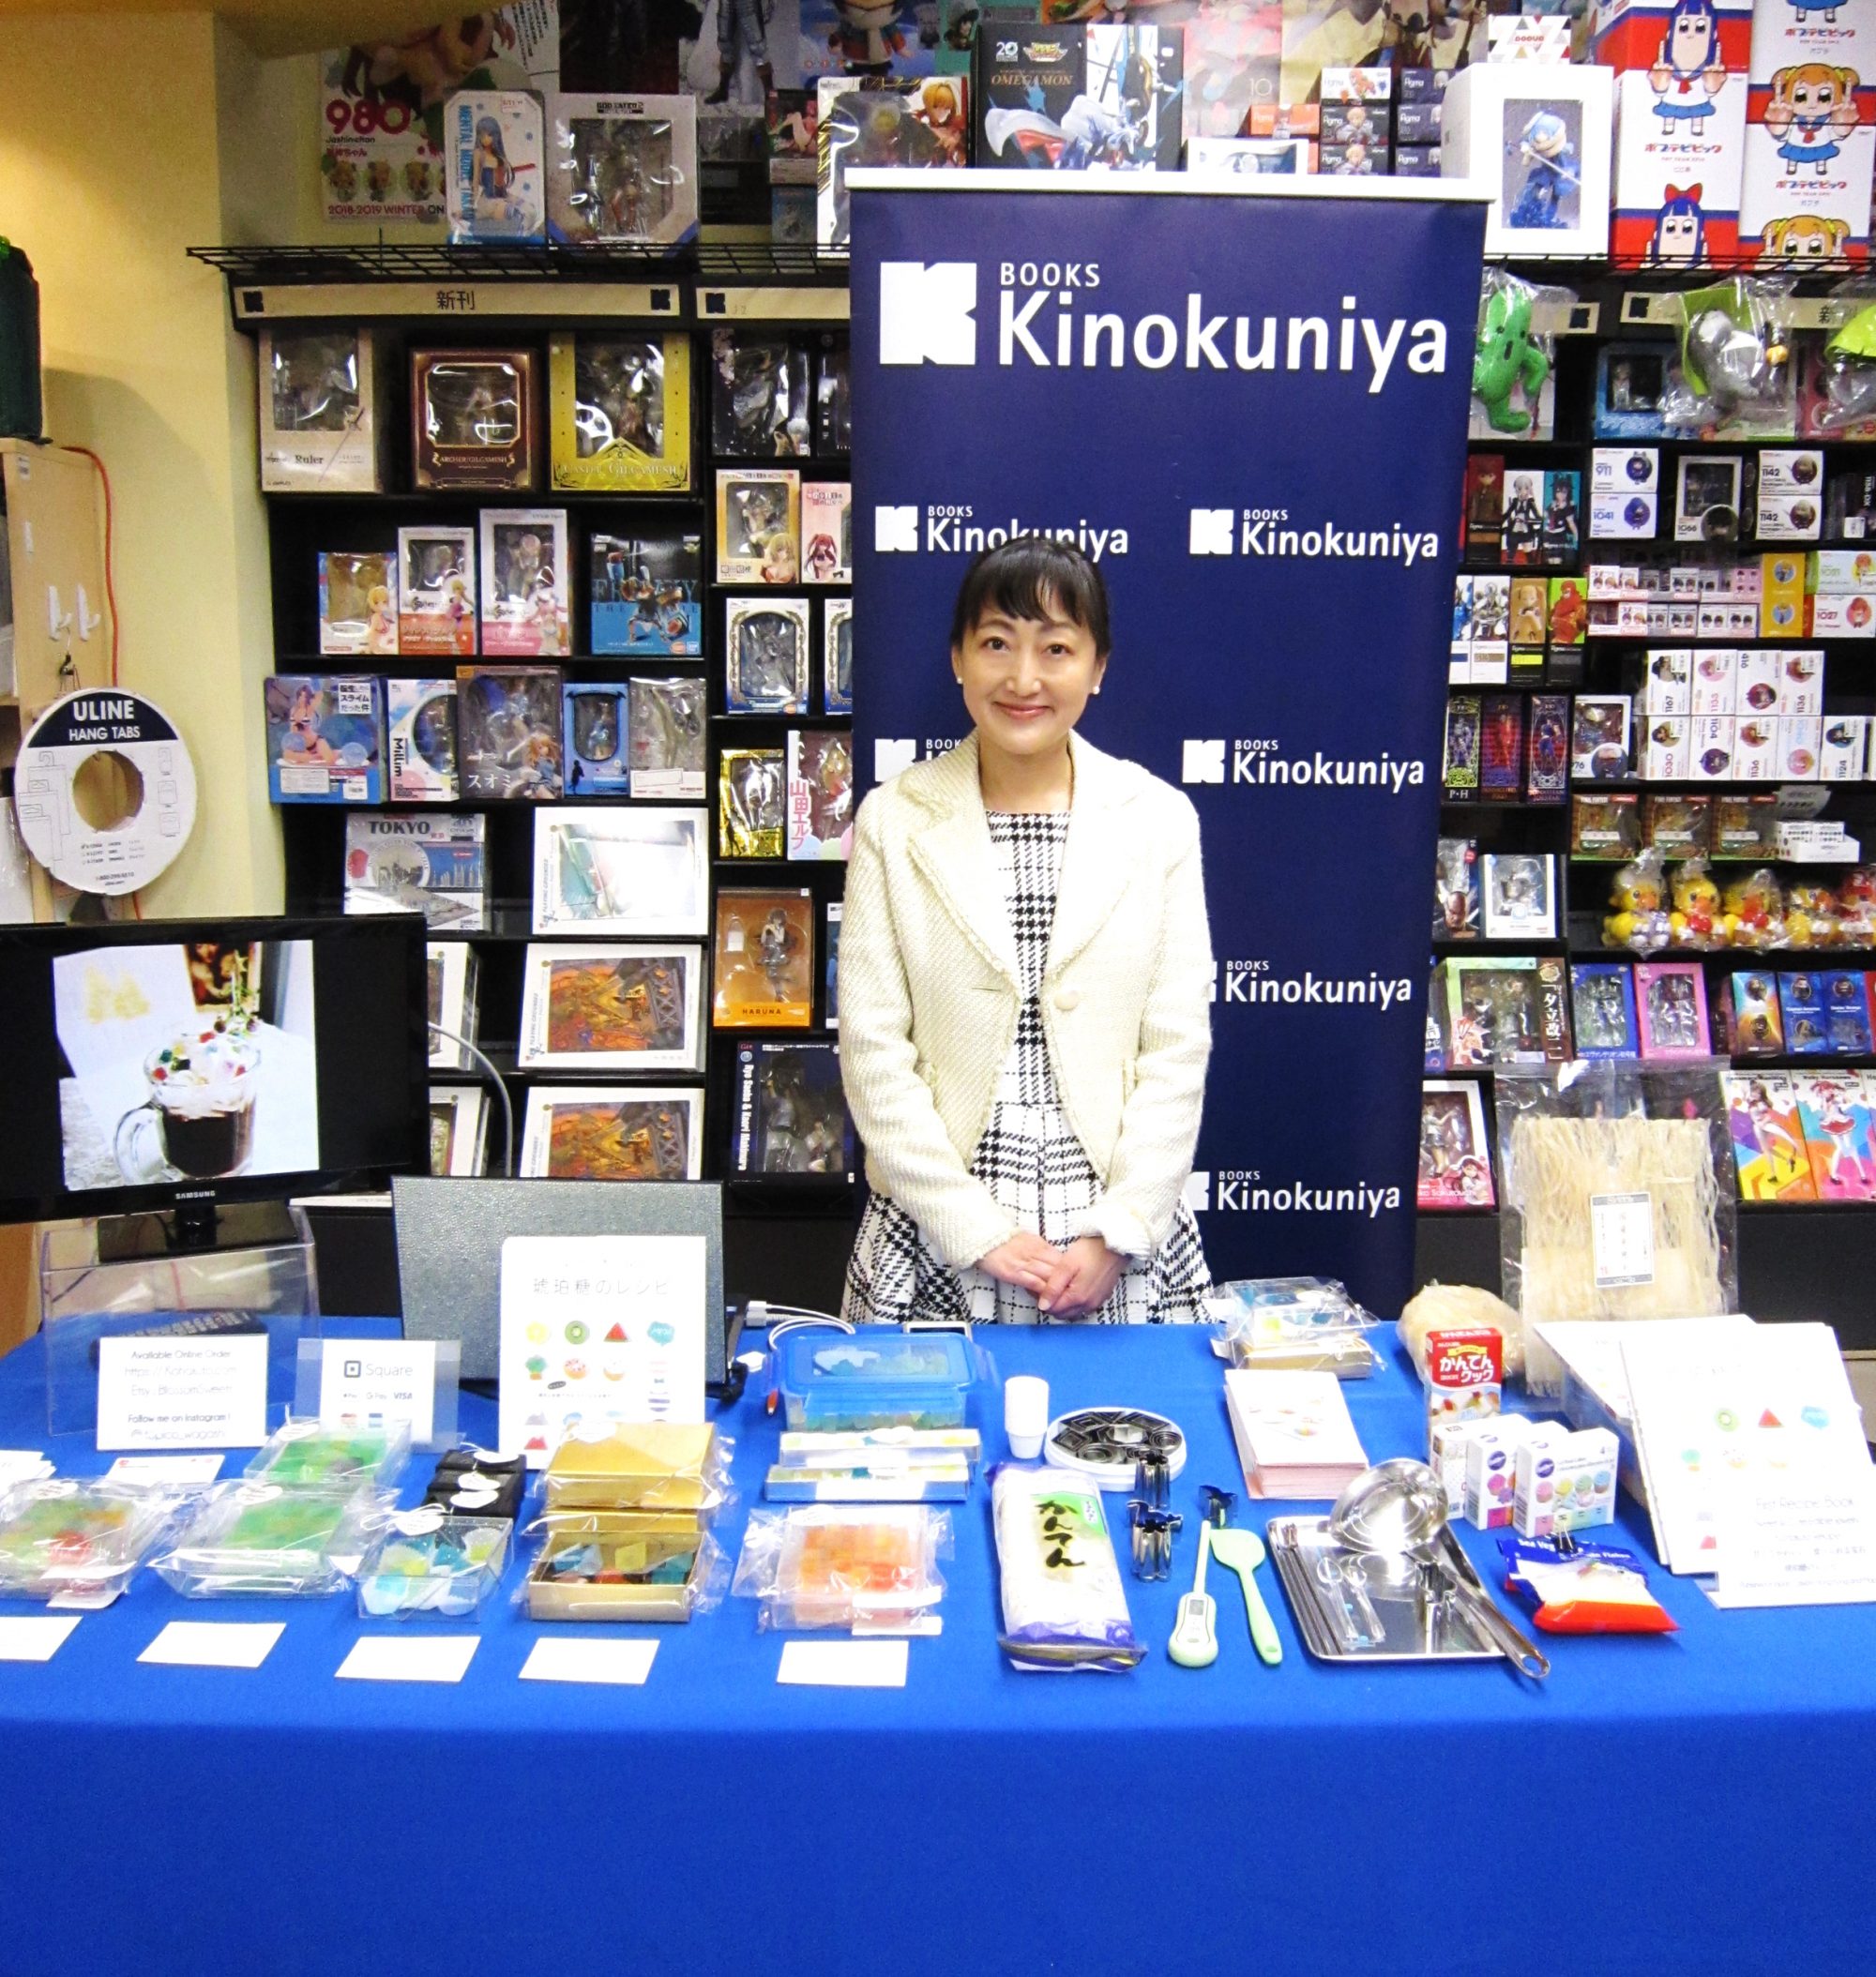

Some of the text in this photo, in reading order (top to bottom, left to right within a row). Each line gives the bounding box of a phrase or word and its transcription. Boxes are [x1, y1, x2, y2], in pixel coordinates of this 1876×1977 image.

[991, 74, 1073, 85] OMEGAMON
[1249, 77, 1273, 97] 10
[325, 98, 411, 135] 980
[1644, 143, 1722, 155] ポプテピピック
[328, 204, 384, 216] 2018-2019
[386, 204, 425, 215] WINTER
[1000, 263, 1101, 288] BOOKS
[436, 290, 477, 311] 新刊
[999, 290, 1447, 394] Kinokuniya
[295, 454, 325, 465] Ruler
[1596, 465, 1612, 476] 911
[1762, 468, 1780, 476] 1142
[928, 506, 973, 517] BOOKS
[1243, 509, 1289, 521] BOOKS
[1594, 511, 1613, 521] 1041
[1760, 513, 1779, 521] 1142
[1678, 524, 1697, 533] 1066
[1242, 521, 1439, 566] Kinokuniya
[1817, 611, 1838, 620] 1027
[340, 694, 370, 702] スライム
[1665, 695, 1673, 713] 1167
[1796, 695, 1806, 713] 1136
[73, 700, 135, 722] ULINE
[340, 703, 370, 713] だった件
[68, 726, 141, 741] HANG TABS
[1710, 717, 1718, 739] 1104
[926, 738, 961, 749] BOOK
[1234, 740, 1278, 750] BOOKS
[1665, 753, 1673, 777] 1030
[1750, 759, 1760, 777] 1136
[1838, 759, 1847, 778] 1124
[1233, 752, 1425, 793] Kinokuniya
[467, 773, 511, 790] スオミ
[789, 780, 809, 851] 山田エルフ
[368, 821, 431, 835] TOKYO
[1226, 960, 1269, 971] BOOKS
[1225, 972, 1413, 1011] Kinokuniya
[742, 1007, 782, 1016] HARUNA
[743, 1064, 754, 1079] Ryo
[742, 1079, 753, 1102] Saeba
[740, 1111, 752, 1132] Kaori
[738, 1133, 750, 1171] Makimura
[1218, 1170, 1261, 1181] BOOKS
[175, 1190, 216, 1200] SAMSUNG
[1218, 1181, 1400, 1217] Kinokuniya
[533, 1277, 669, 1295] 琥珀糖のレシピ
[131, 1350, 232, 1360] Available Online Order
[1440, 1354, 1494, 1372] かんてん
[365, 1364, 414, 1378] Square
[1460, 1369, 1494, 1383] クック
[128, 1414, 155, 1424] Follow
[1035, 1500, 1086, 1568] かんてん
[1517, 1538, 1536, 1548] Sea
